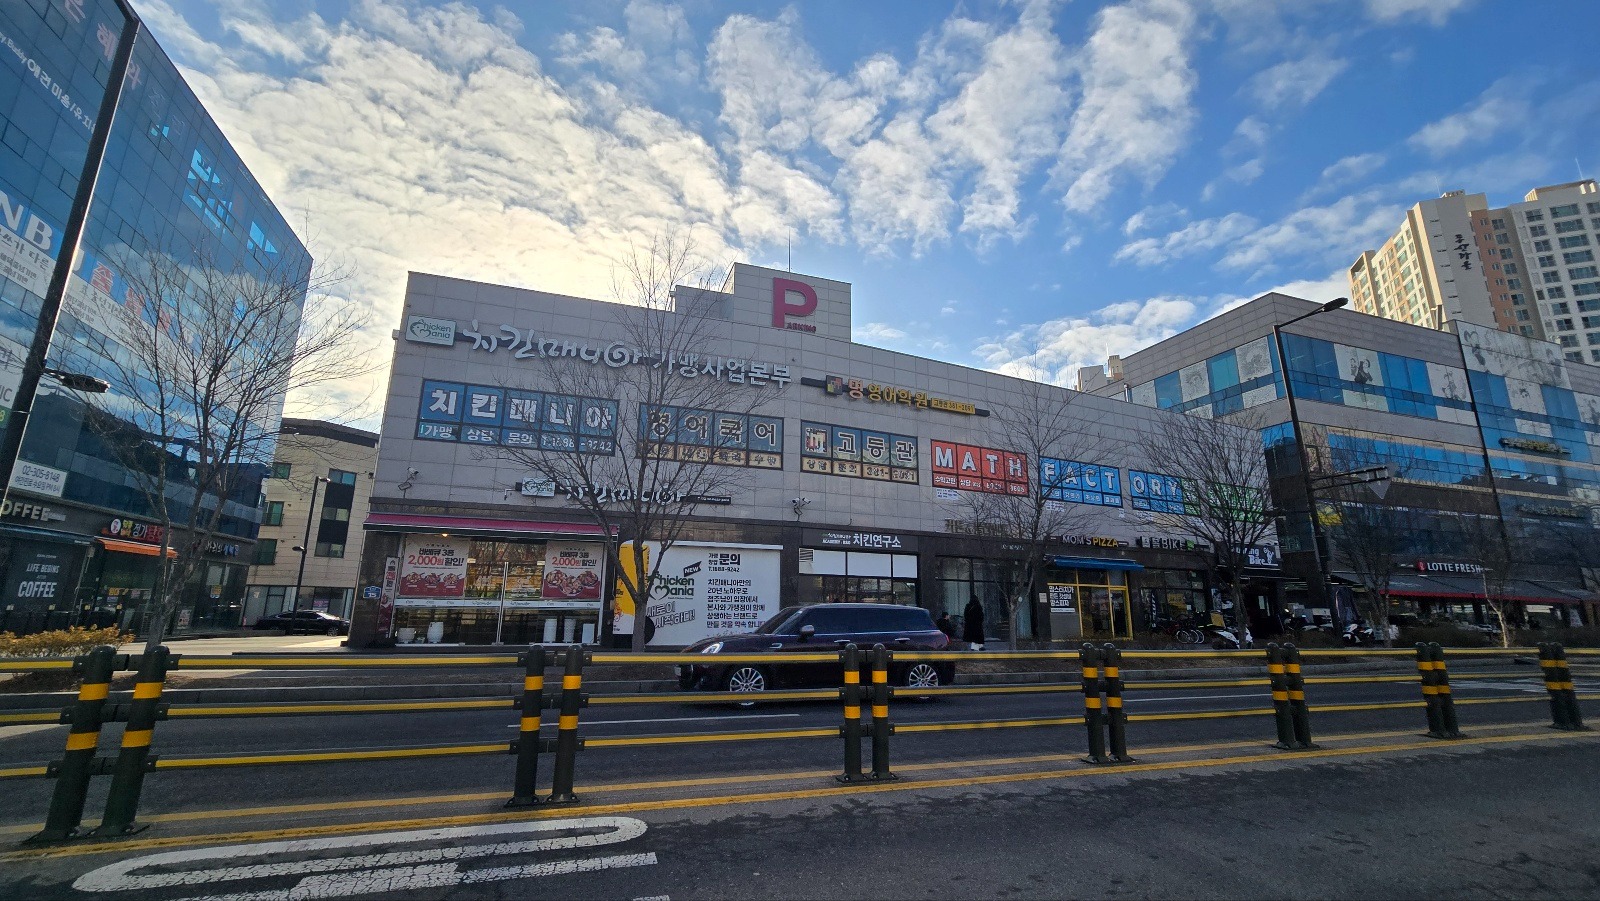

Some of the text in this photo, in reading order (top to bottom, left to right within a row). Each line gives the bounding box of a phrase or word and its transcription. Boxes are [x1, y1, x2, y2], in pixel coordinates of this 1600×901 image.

[652, 351, 792, 390] 가맹사업본부
[848, 379, 929, 410] 명 영어학원
[429, 388, 613, 430] 치킨매니아
[424, 427, 453, 439] 가맹
[467, 430, 494, 442] 상담
[838, 431, 918, 462] 고등관
[936, 446, 1023, 478] MATH
[853, 533, 902, 549] 치킨연구소
[1061, 534, 1120, 550] MOM'S PIZZA
[408, 555, 464, 566] 2,000원 할인!
[552, 557, 597, 567] 2,000원 할인!
[719, 553, 741, 566] 문의
[684, 566, 699, 574] NEW
[1427, 562, 1482, 575] LOTTE FRESH
[18, 581, 57, 598] COFFEE
[707, 587, 723, 595] 20년
